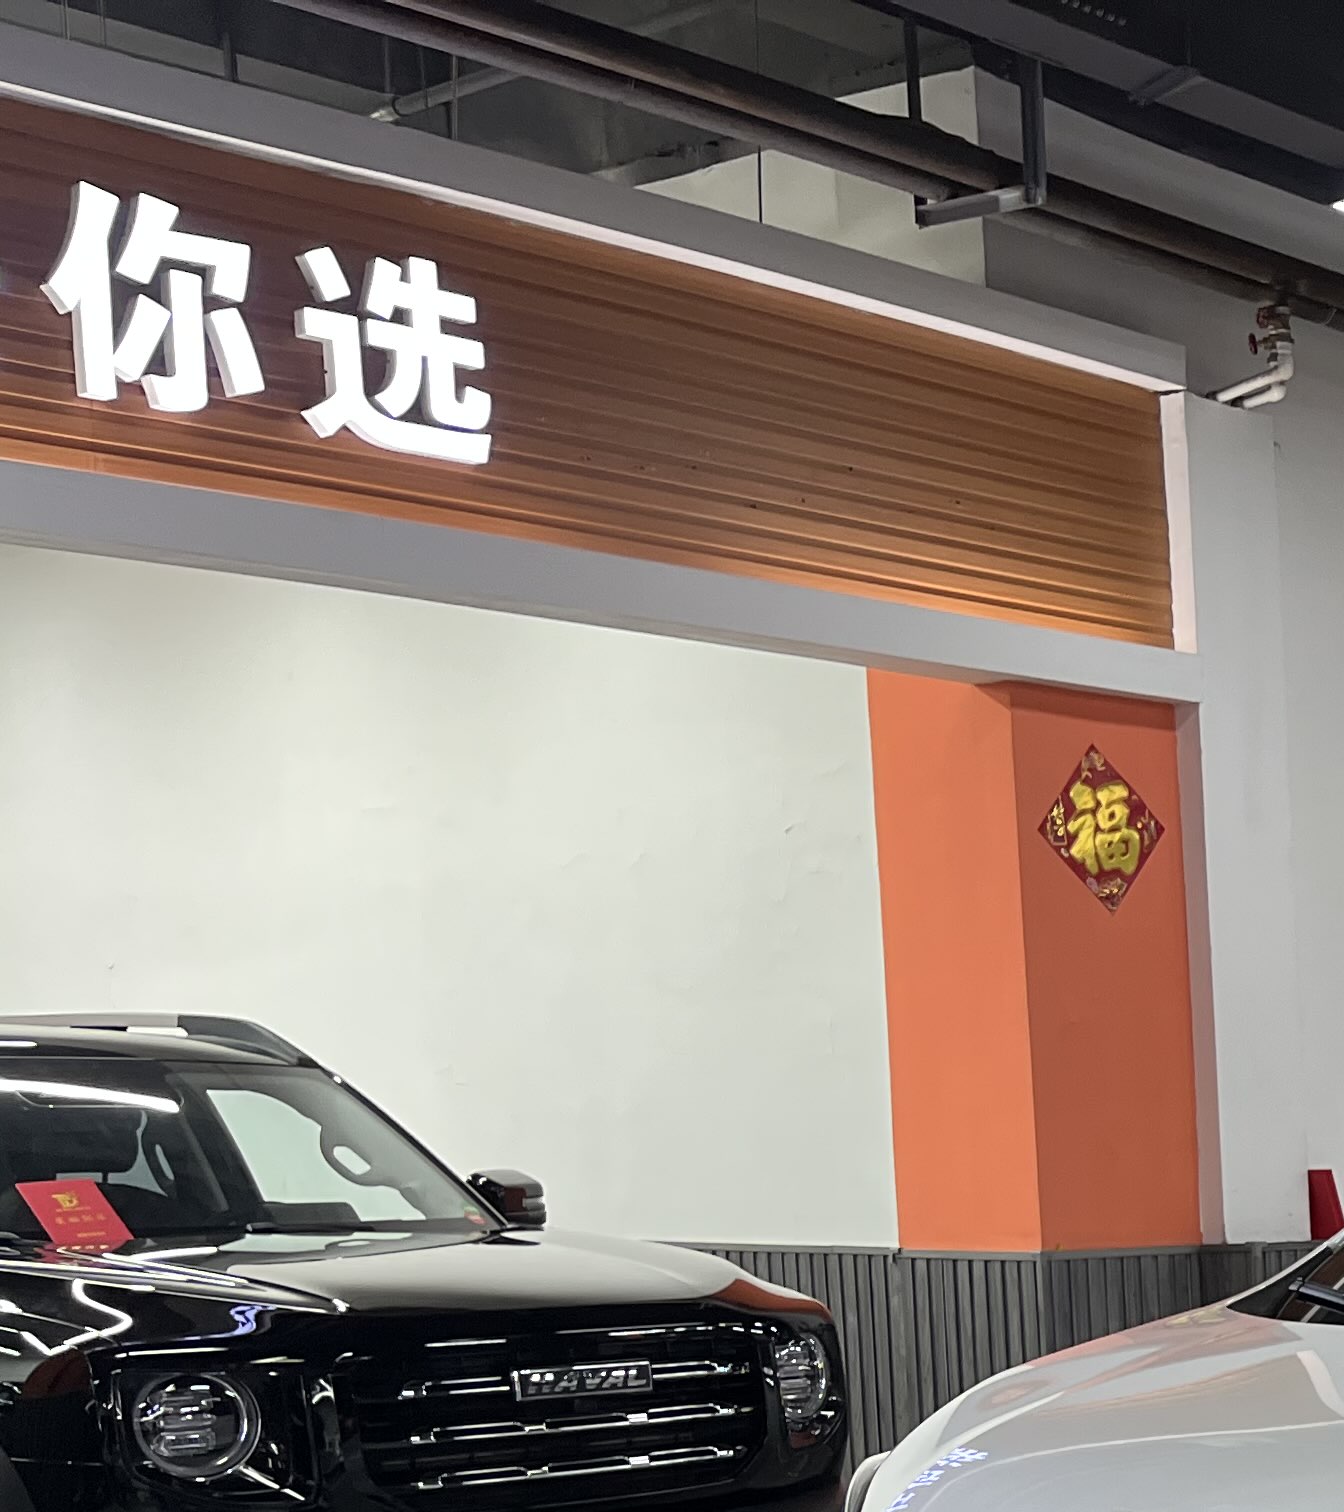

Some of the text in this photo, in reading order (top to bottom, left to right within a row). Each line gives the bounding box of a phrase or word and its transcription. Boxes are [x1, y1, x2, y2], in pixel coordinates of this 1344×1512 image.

[40, 180, 492, 465] 你选
[1066, 780, 1141, 877] 福
[527, 1368, 648, 1395] HAVAL
